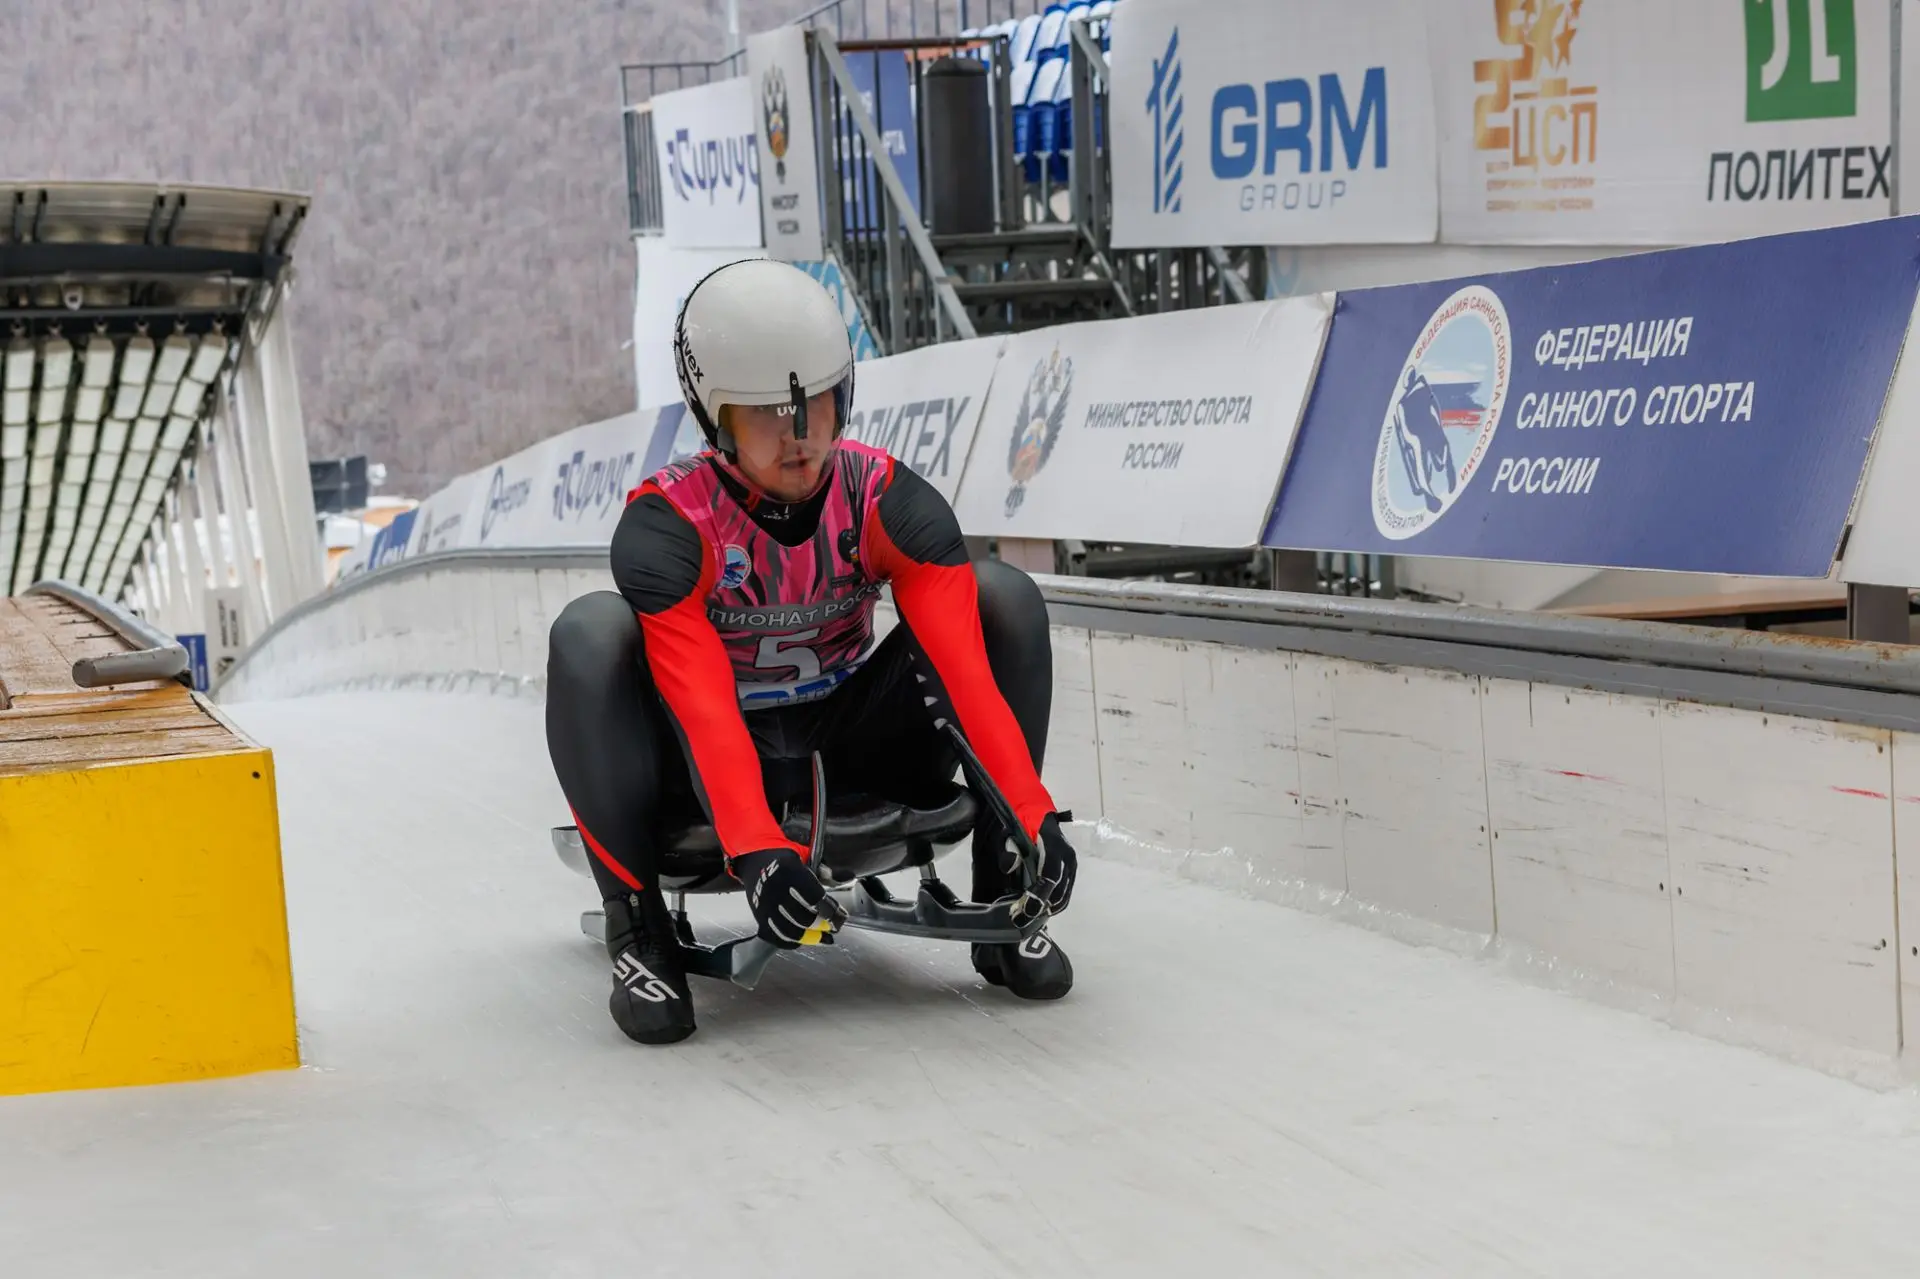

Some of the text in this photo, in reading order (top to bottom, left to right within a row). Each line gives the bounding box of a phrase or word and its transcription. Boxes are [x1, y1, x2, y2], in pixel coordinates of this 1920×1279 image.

[1210, 66, 1388, 180] GRM
[1513, 102, 1598, 173] ЦСП
[1240, 180, 1347, 212] GROUP
[1708, 146, 1892, 202] ПОЛИТЕХ
[1535, 316, 1694, 371] ФЕДЕРАЦИЯ
[1084, 395, 1252, 428] МИНИСТЕРСТВО СПОРТА
[1516, 381, 1755, 430] САННОГО СПОРТА
[1121, 441, 1184, 469] РОССИИ
[1491, 456, 1600, 494] РОССИИ
[755, 628, 820, 682] 5
